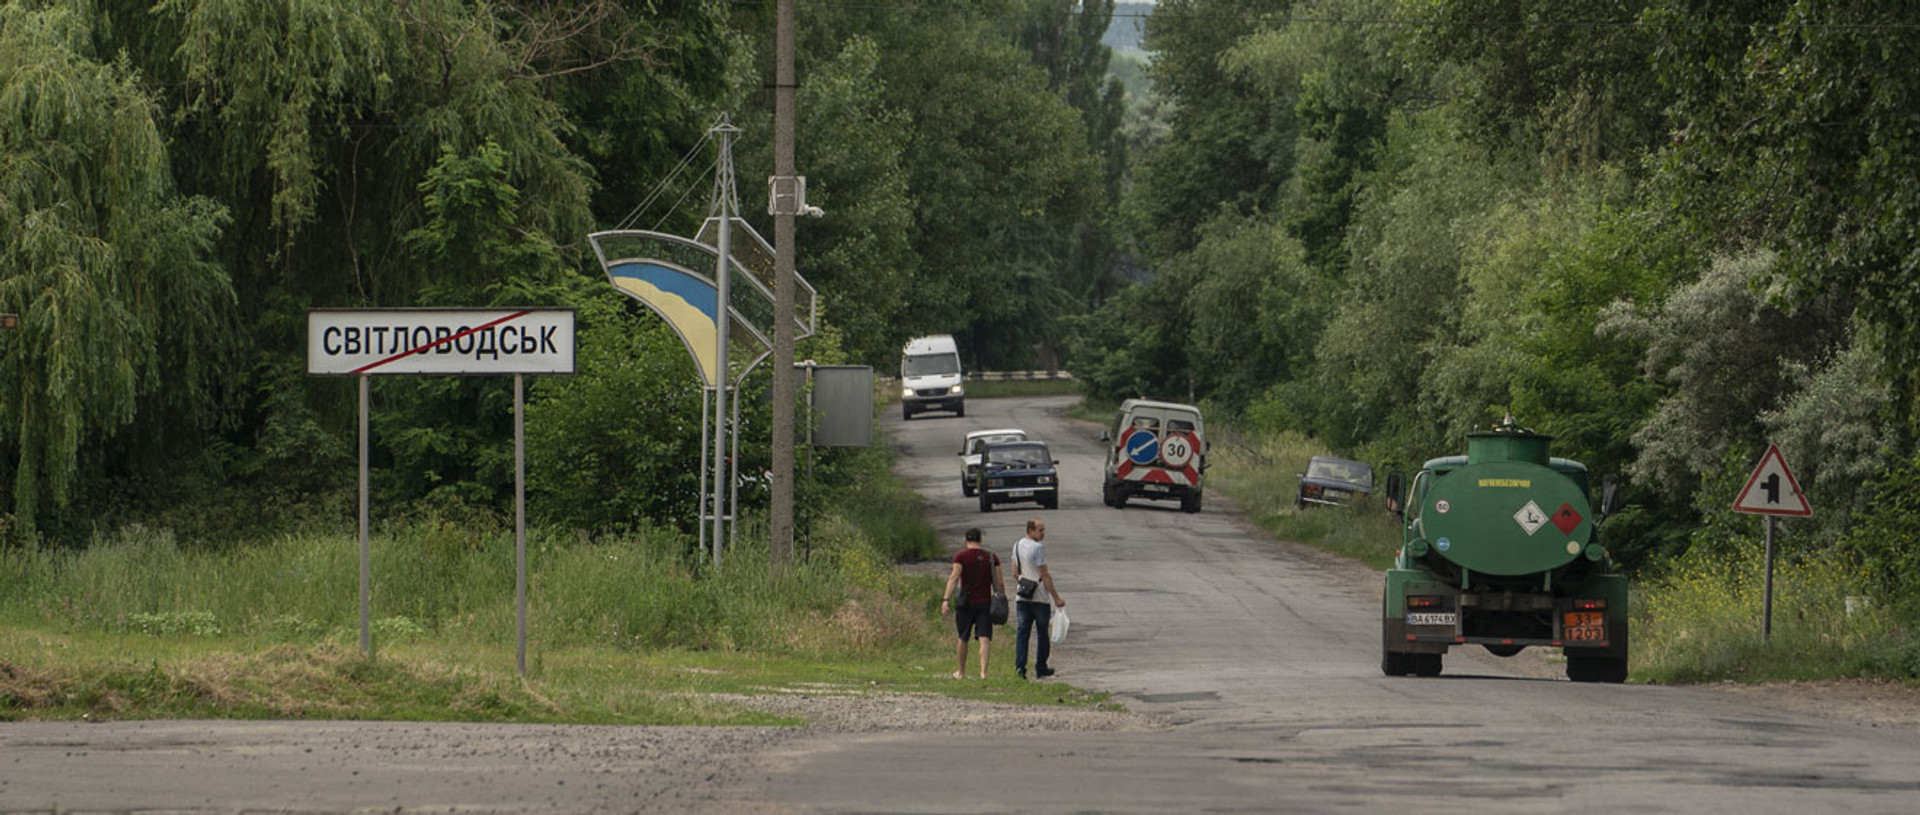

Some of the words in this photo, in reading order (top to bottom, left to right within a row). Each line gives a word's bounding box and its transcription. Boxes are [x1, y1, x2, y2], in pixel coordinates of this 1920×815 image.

[323, 325, 557, 360] СВІТЛОВОДСЬК
[1167, 443, 1186, 458] 30
[1576, 613, 1591, 625] 33
[1567, 628, 1602, 640] 1203
